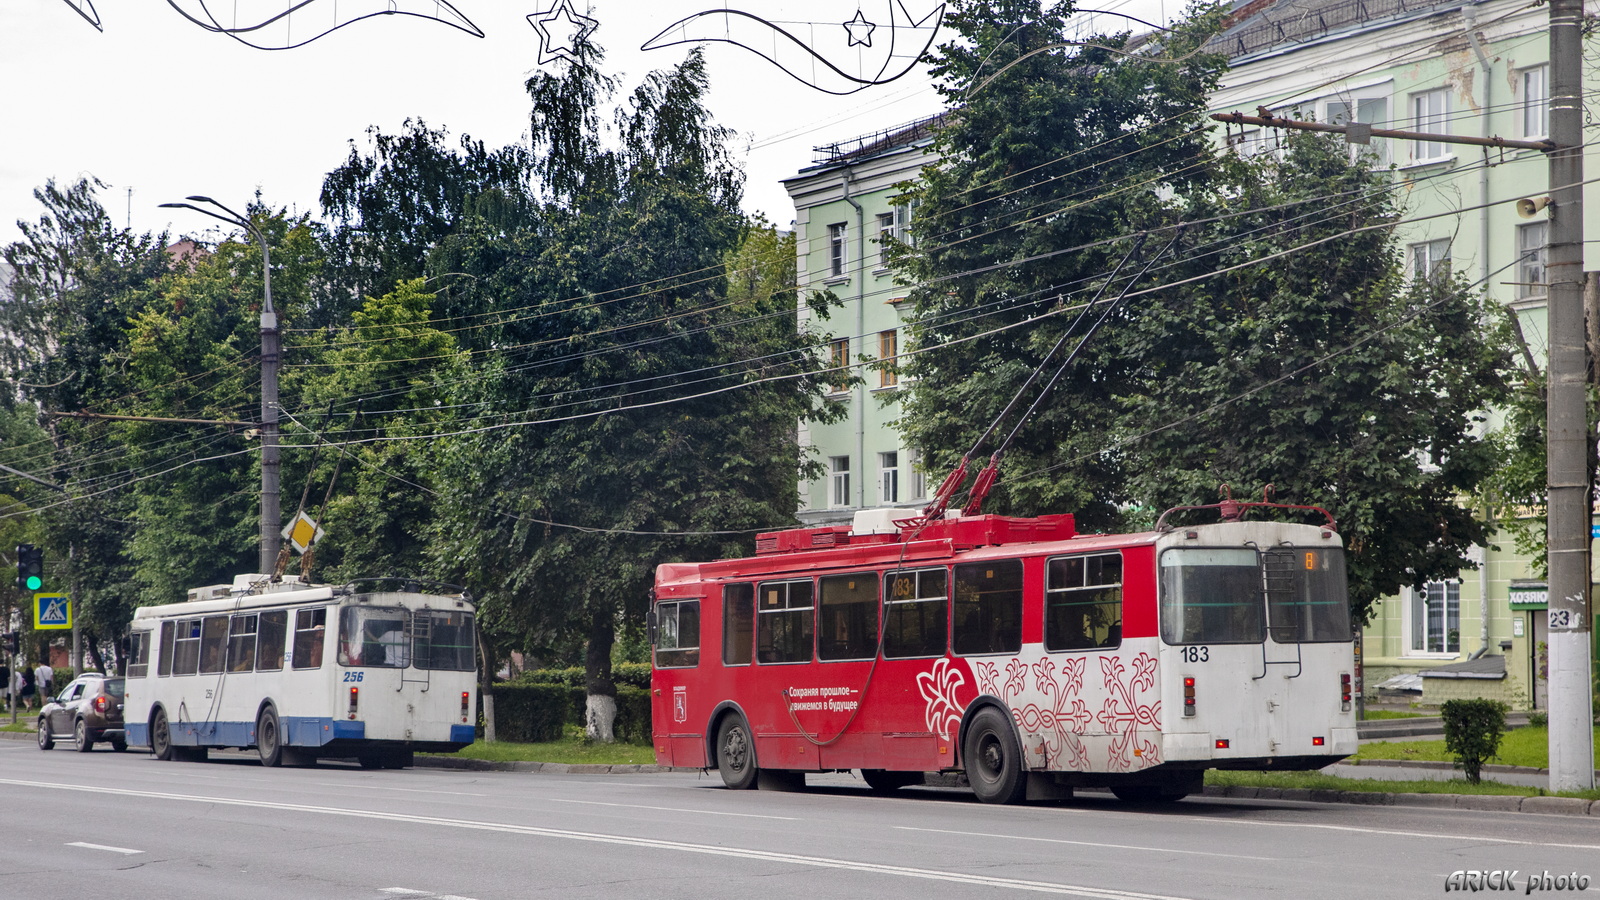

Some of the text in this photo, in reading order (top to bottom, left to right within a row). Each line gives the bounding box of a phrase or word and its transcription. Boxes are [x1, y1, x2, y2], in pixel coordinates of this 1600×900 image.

[1180, 646, 1210, 663] 183
[343, 671, 364, 682] 256
[789, 686, 819, 699] Сохраняя
[819, 686, 850, 698] прошлое
[823, 702, 828, 710] в
[828, 698, 858, 713] будущее
